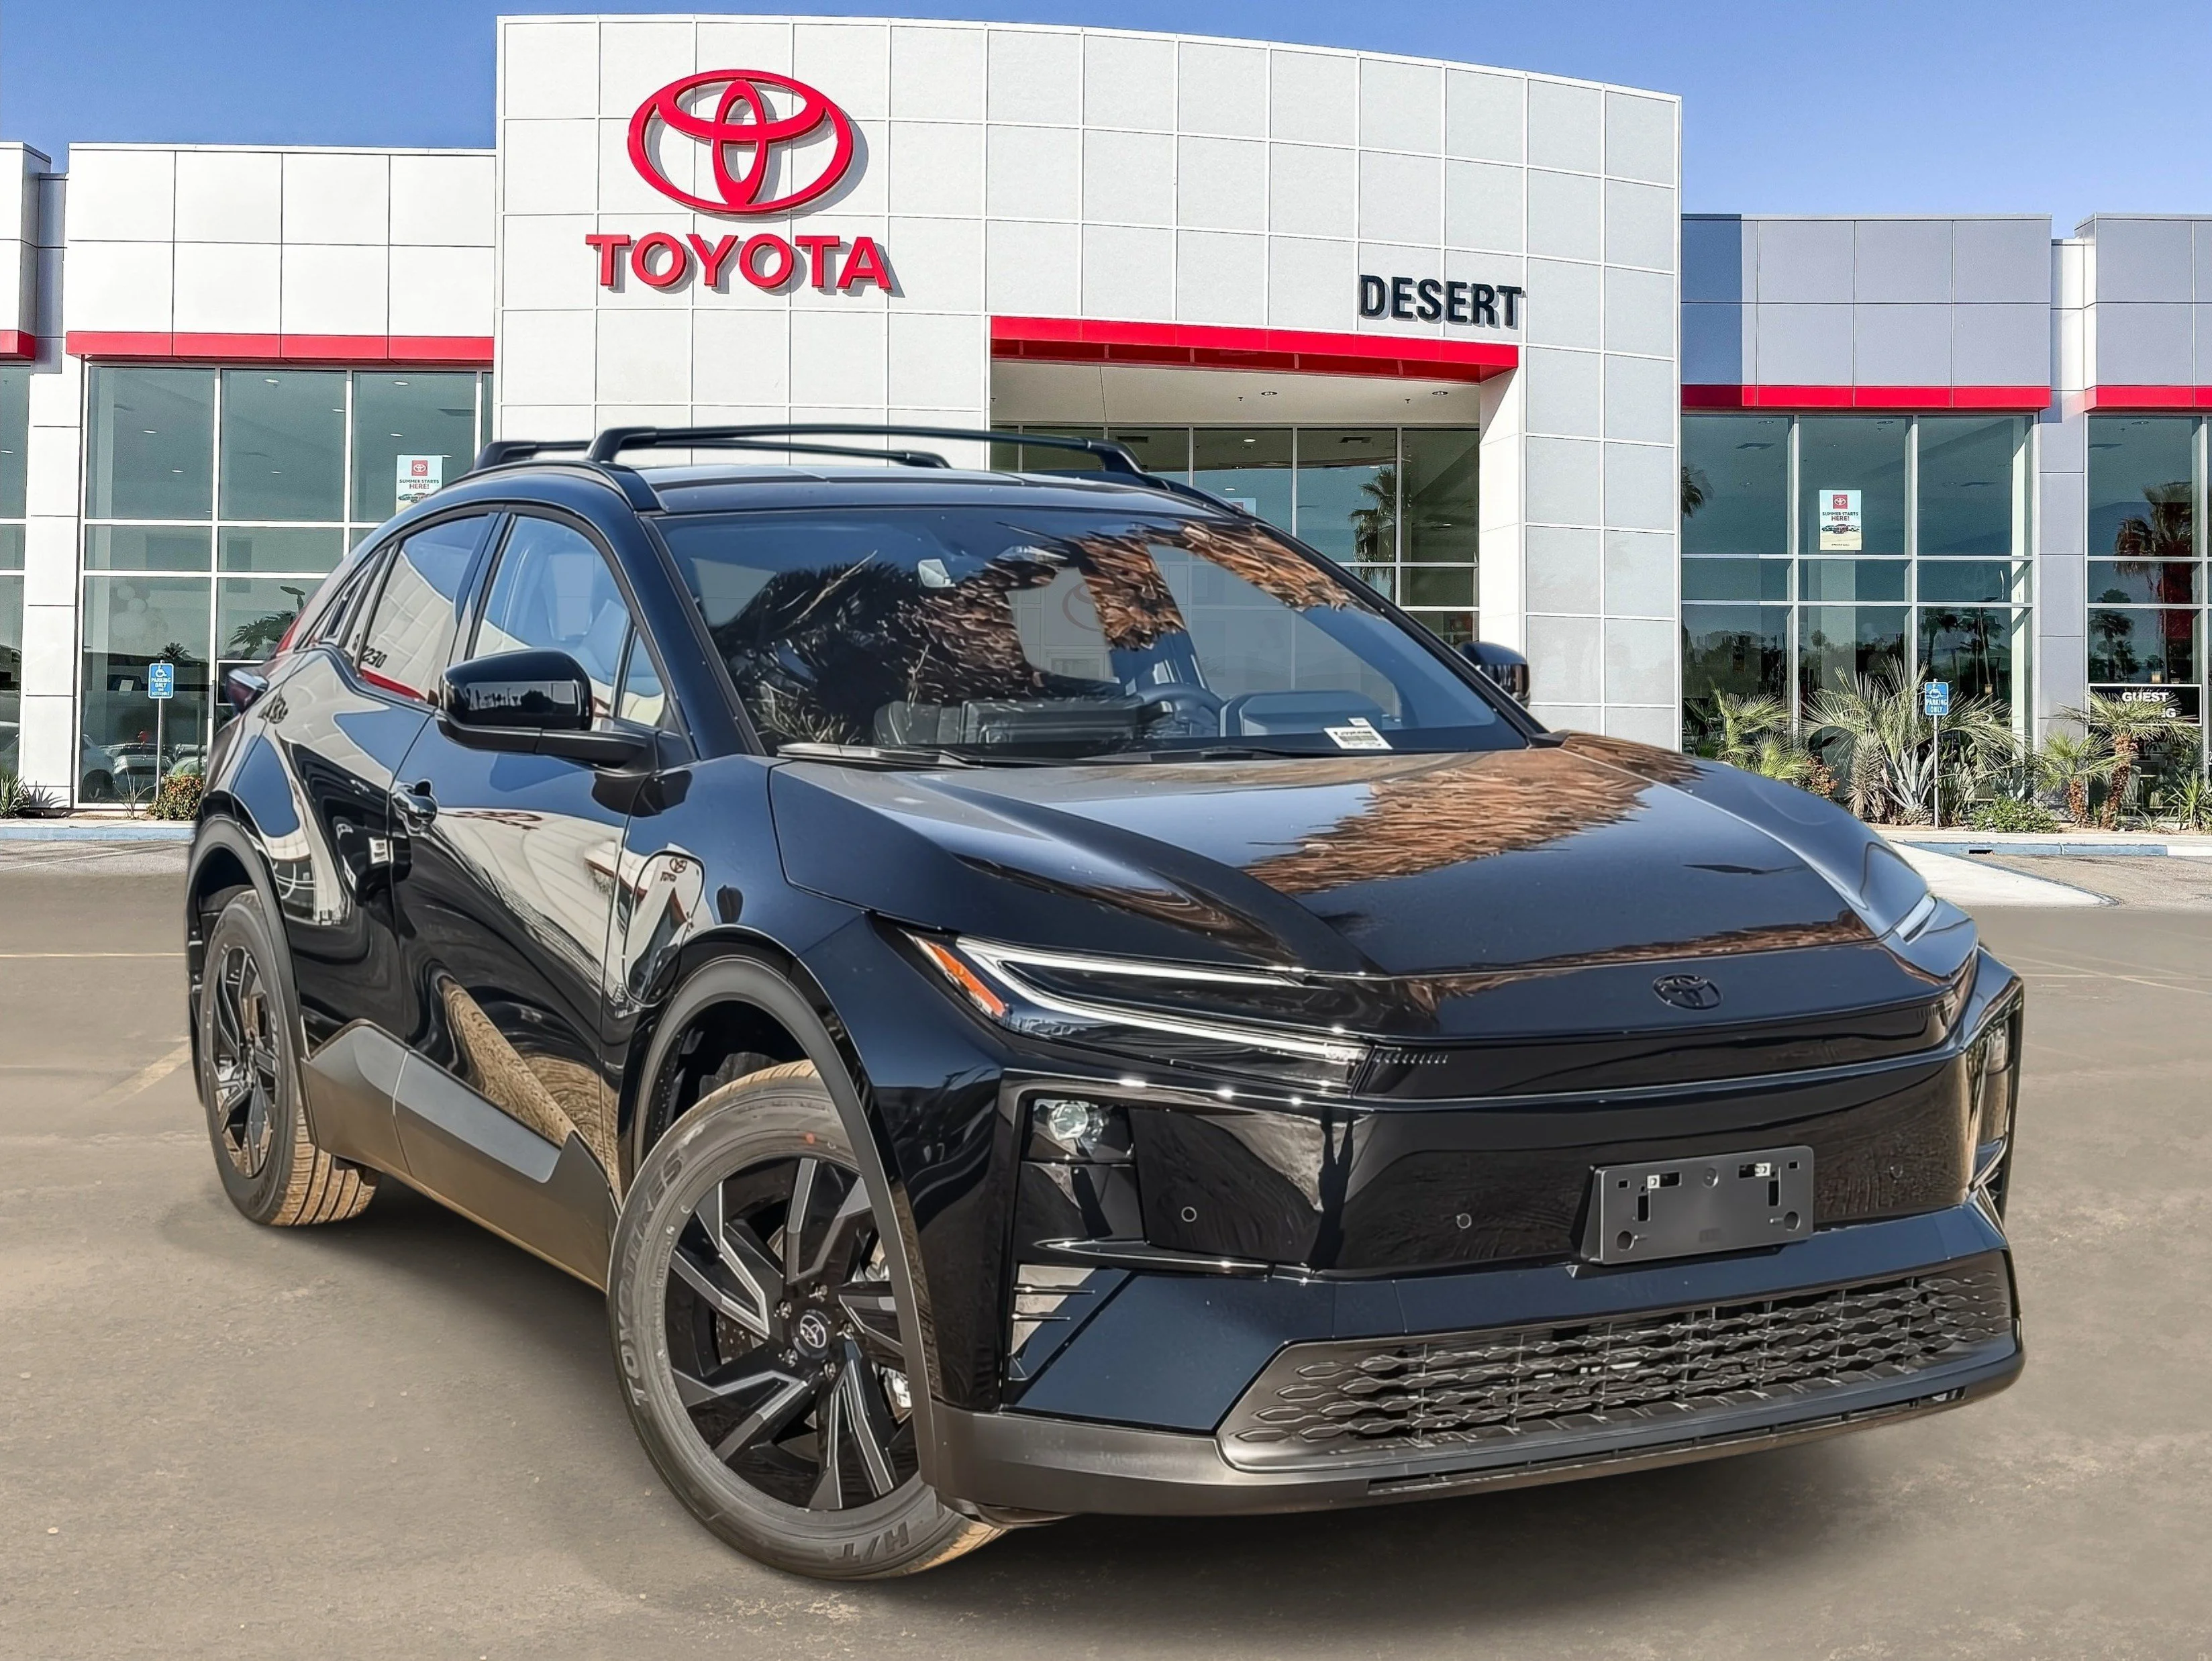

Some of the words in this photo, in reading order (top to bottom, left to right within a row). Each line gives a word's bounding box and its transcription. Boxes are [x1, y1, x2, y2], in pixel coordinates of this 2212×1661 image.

[585, 232, 892, 290] TOYOTA
[1359, 274, 1522, 326] DESERT
[2121, 692, 2169, 703] GUEST
